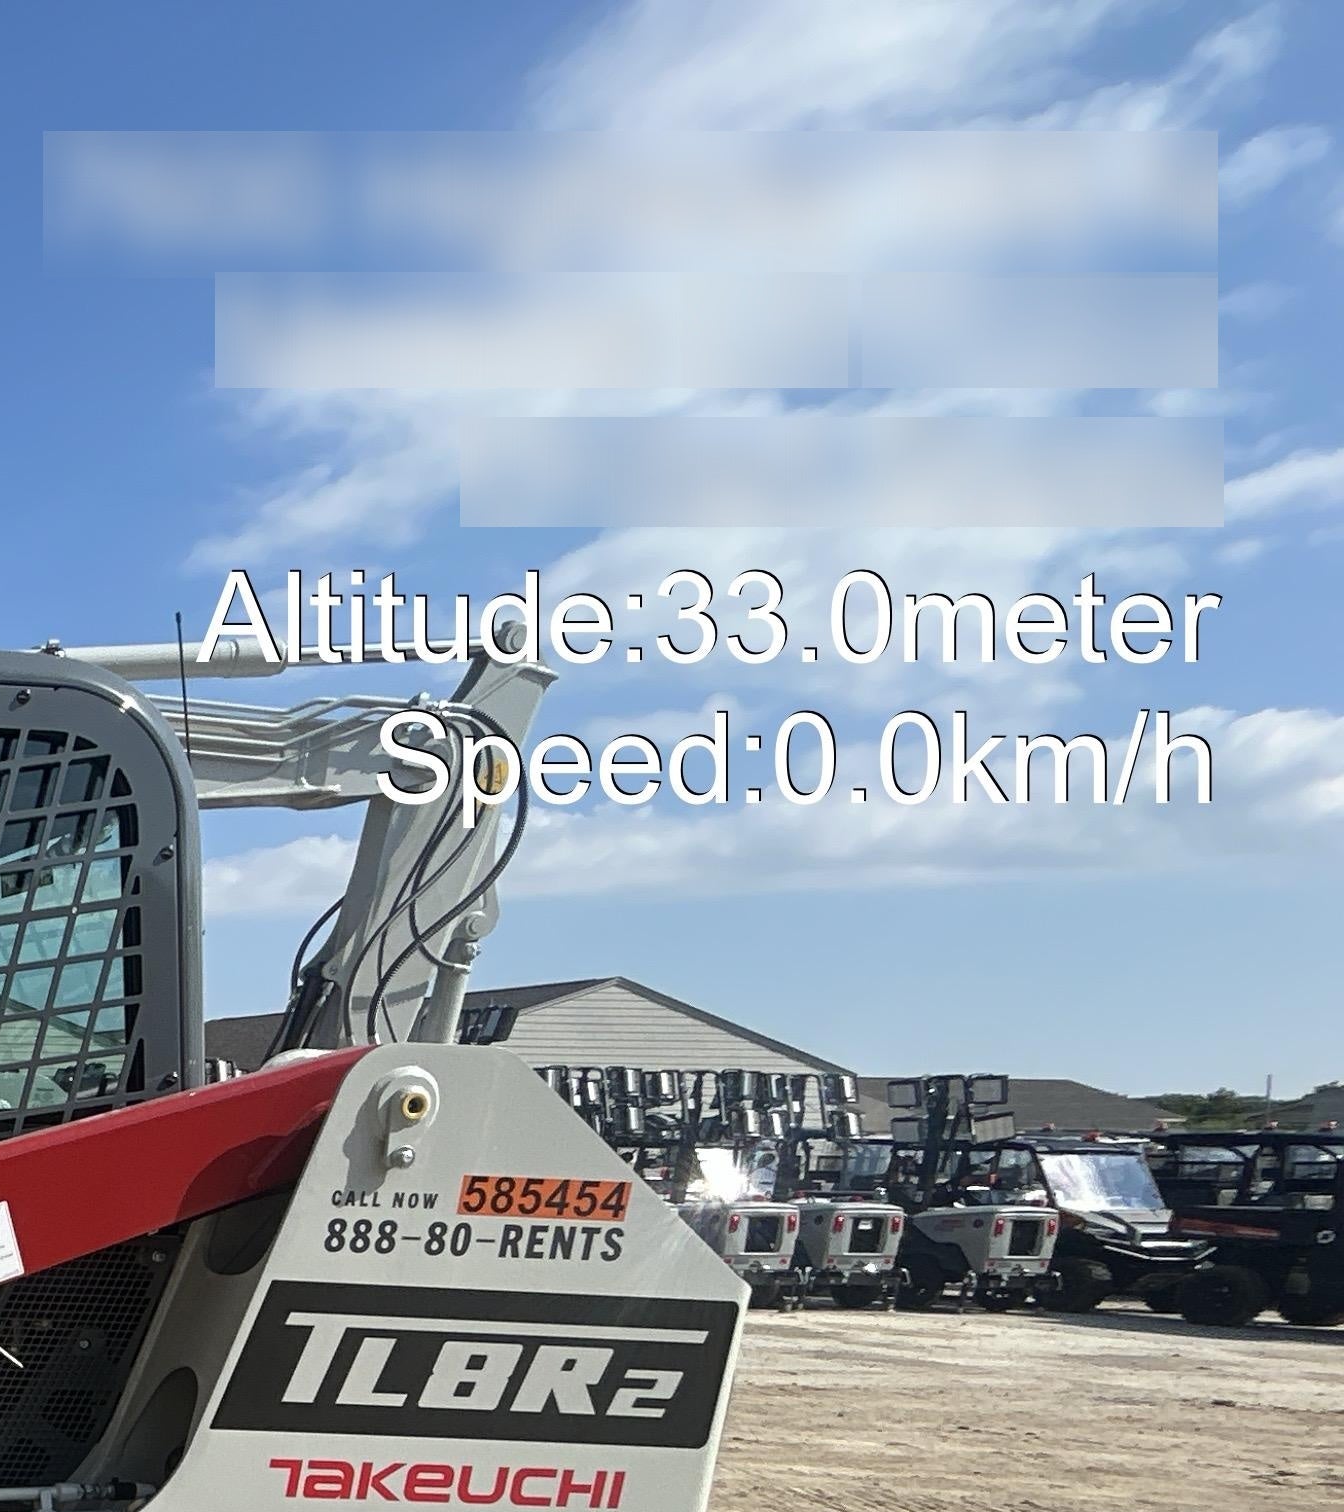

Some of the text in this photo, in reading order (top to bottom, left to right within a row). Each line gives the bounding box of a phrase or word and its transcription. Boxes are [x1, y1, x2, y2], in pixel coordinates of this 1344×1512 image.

[331, 1189, 439, 1210] CALL NOW
[462, 1175, 627, 1219] 585454
[323, 1217, 626, 1262] 888-80-RENTS
[280, 1311, 709, 1418] TL8R2
[268, 1458, 627, 1510] TAKEUCHI
